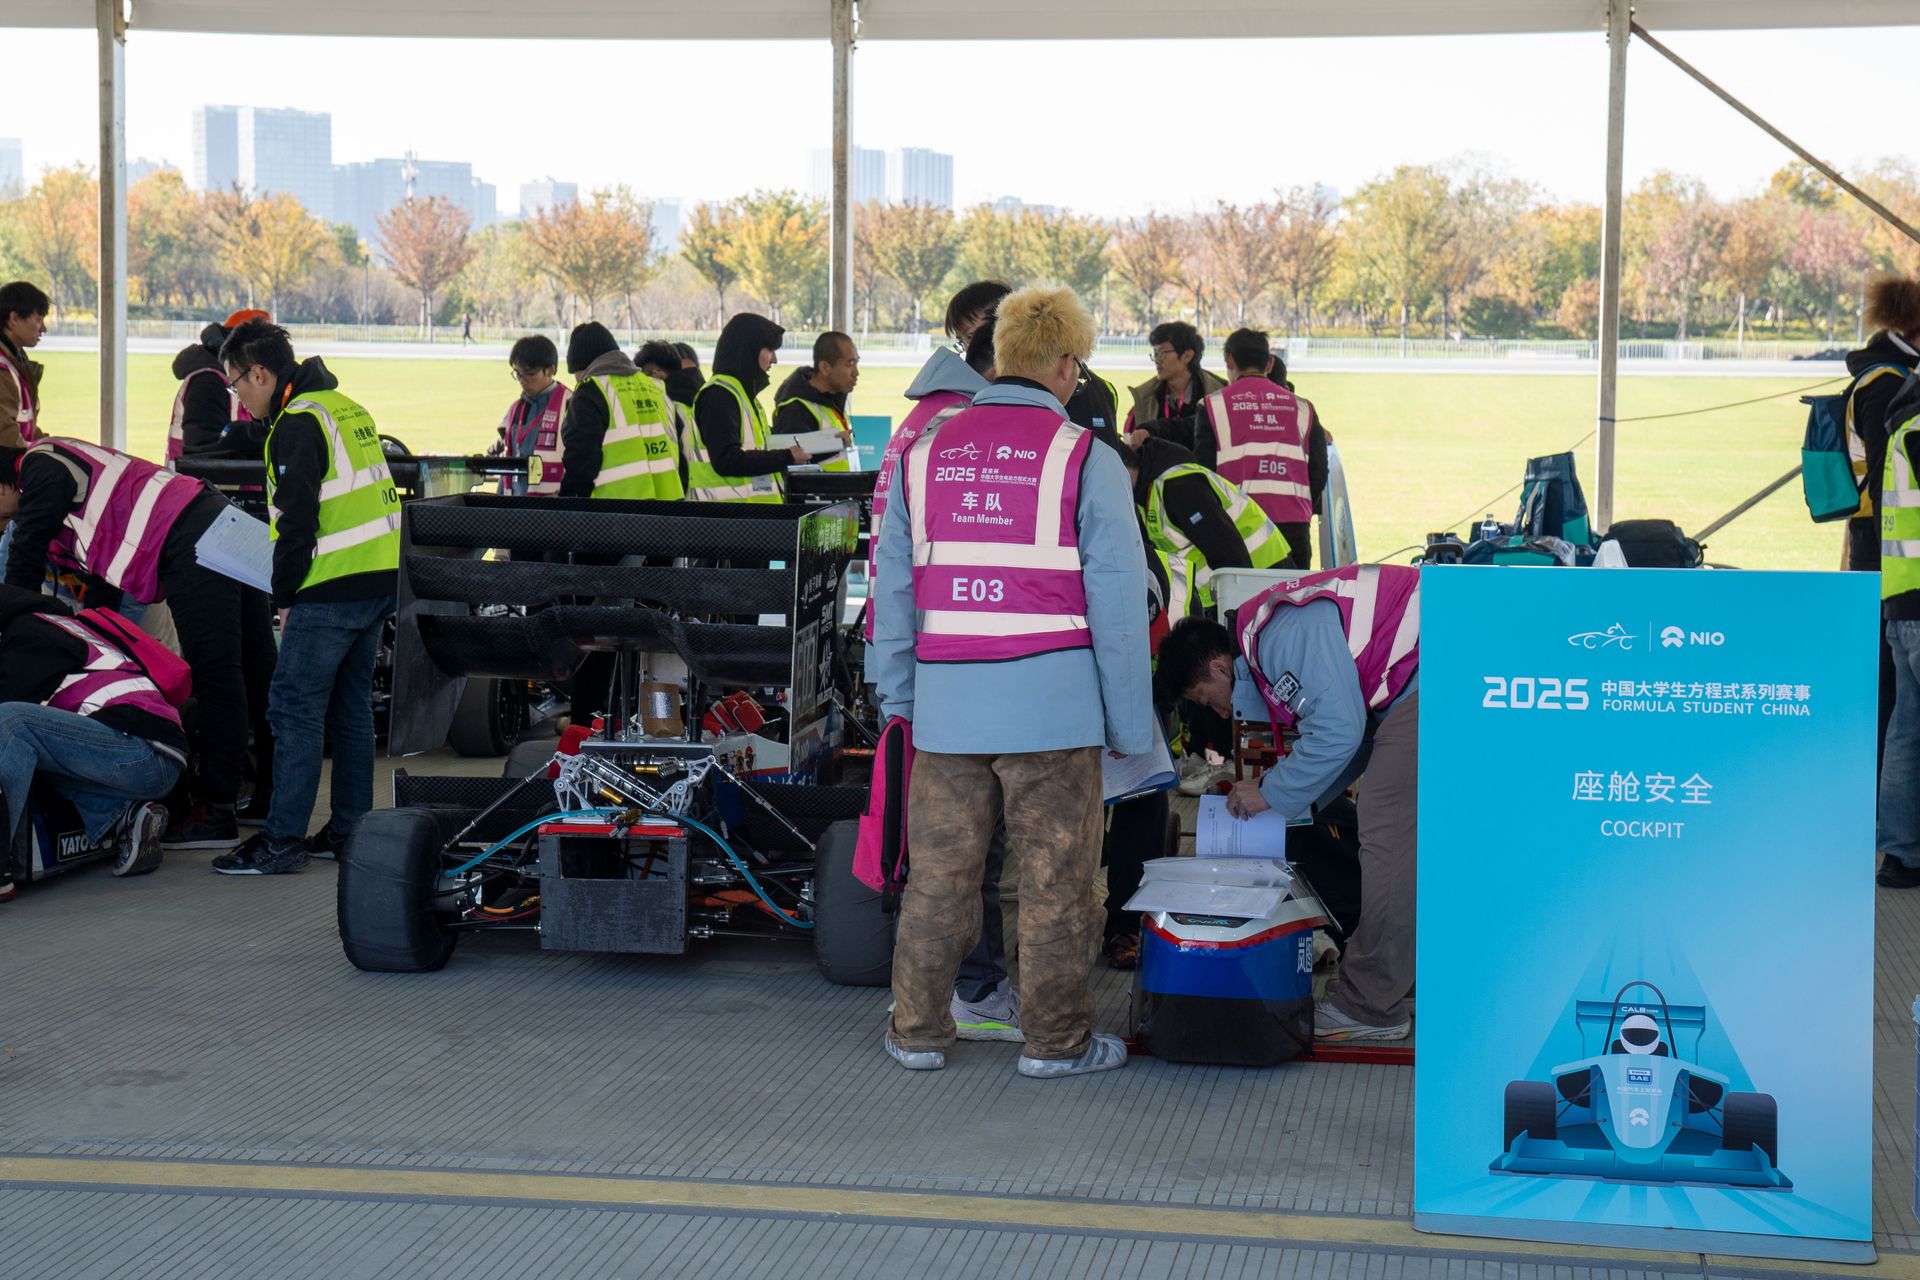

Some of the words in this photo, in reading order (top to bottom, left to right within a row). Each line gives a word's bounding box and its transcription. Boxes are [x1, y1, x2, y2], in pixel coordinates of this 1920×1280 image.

[1232, 402, 1259, 411] 2025
[1014, 449, 1037, 460] NIO
[935, 467, 976, 482] 2025
[1259, 460, 1287, 475] E05
[961, 492, 1003, 511] 车队
[952, 512, 975, 523] Team
[976, 514, 1013, 525] Member
[952, 577, 1004, 602] E03
[1690, 631, 1725, 646] NIO
[1482, 676, 1589, 710] 2025
[1601, 680, 1811, 701] 中国大学生方程式系列赛事
[1602, 699, 1676, 713] FORMULA
[1682, 701, 1754, 715] STUDENT
[1761, 703, 1811, 716] CHINA
[1572, 770, 1713, 804] 座舱安全
[1600, 820, 1685, 839] COCKPIT
